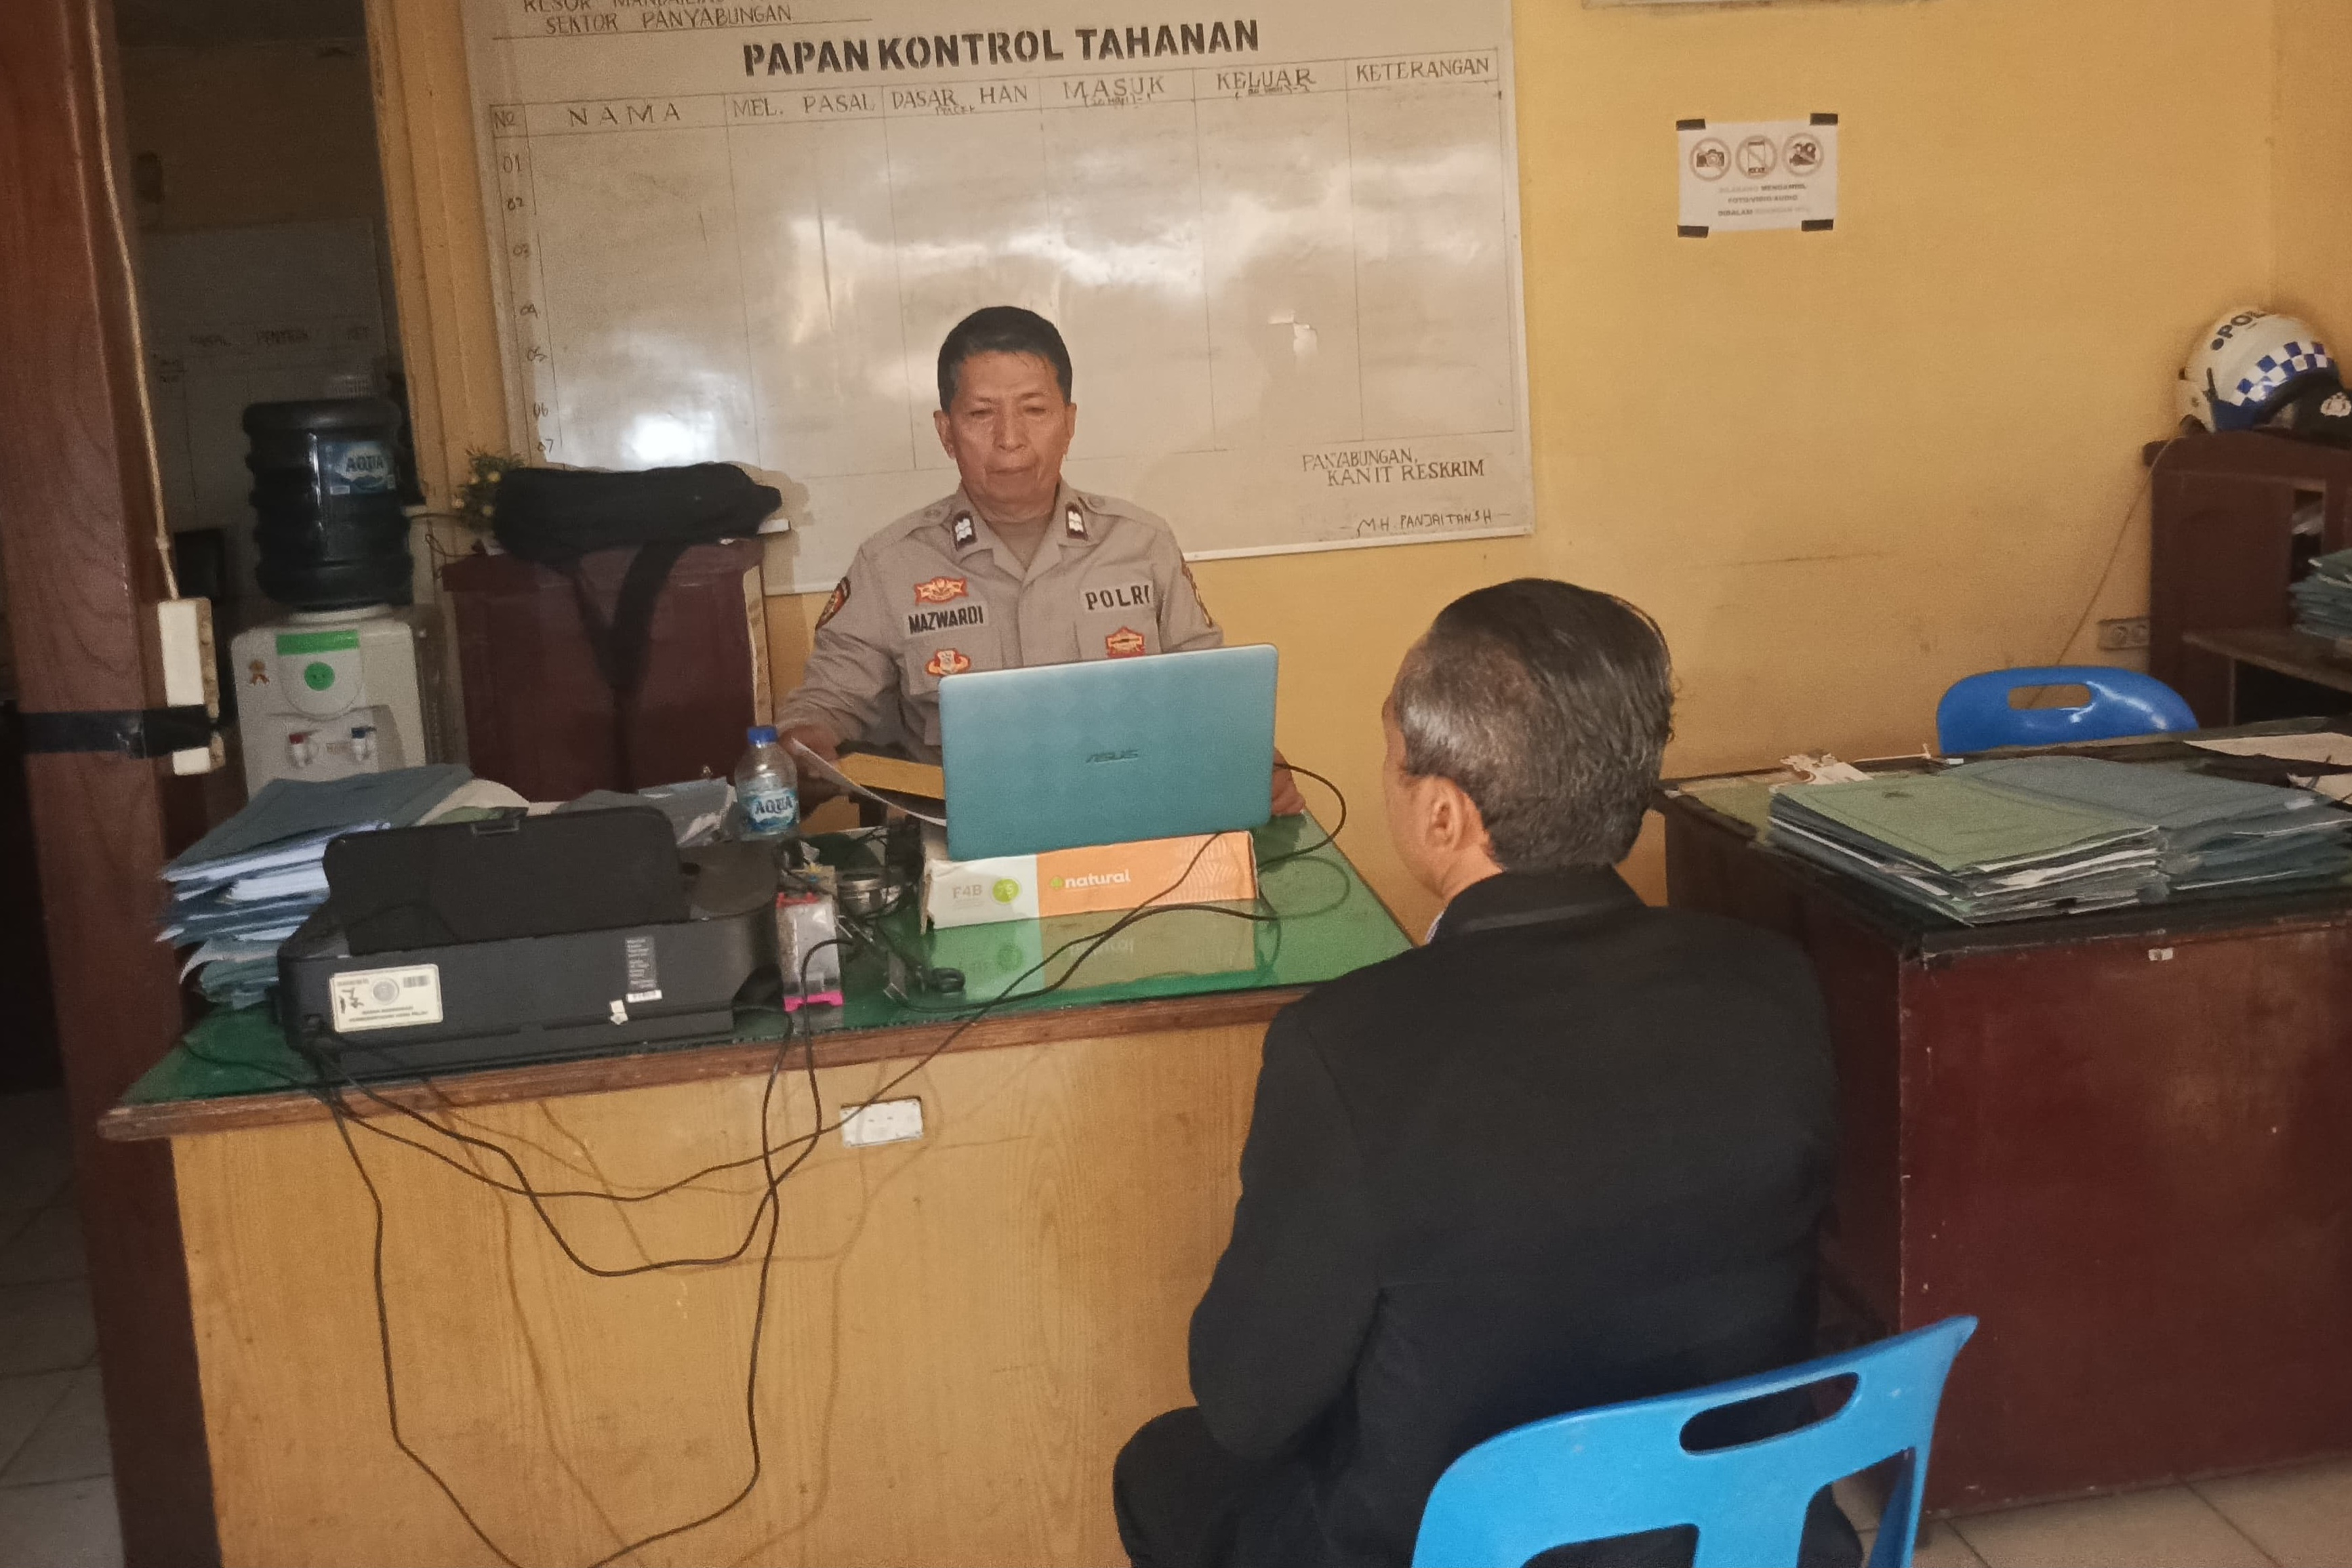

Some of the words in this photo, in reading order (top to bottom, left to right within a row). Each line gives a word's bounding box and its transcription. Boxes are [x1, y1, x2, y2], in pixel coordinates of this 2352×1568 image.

[546, 14, 618, 35] SEKTOR
[642, 5, 792, 29] PANYABUNGAN
[743, 39, 870, 77] PAPAN
[878, 29, 1064, 70] KONTROL
[1075, 19, 1259, 61] TAHANAN
[1215, 68, 1317, 91] KELUAR
[1356, 58, 1489, 83] KETERANGAN
[891, 88, 958, 109] DASAR
[980, 85, 1028, 104] HAN
[1063, 75, 1165, 100] MASUK
[569, 102, 681, 127] NAMA
[804, 93, 876, 114] PASAL
[346, 455, 384, 472] AQUA
[1326, 466, 1393, 487] KANIT
[1401, 458, 1485, 482] RESKRIM
[1085, 584, 1150, 611] POLRI
[908, 604, 984, 634] MAZWARDI
[1086, 749, 1139, 764] ASUS
[754, 796, 794, 815] AQUA
[1065, 868, 1131, 889] natural
